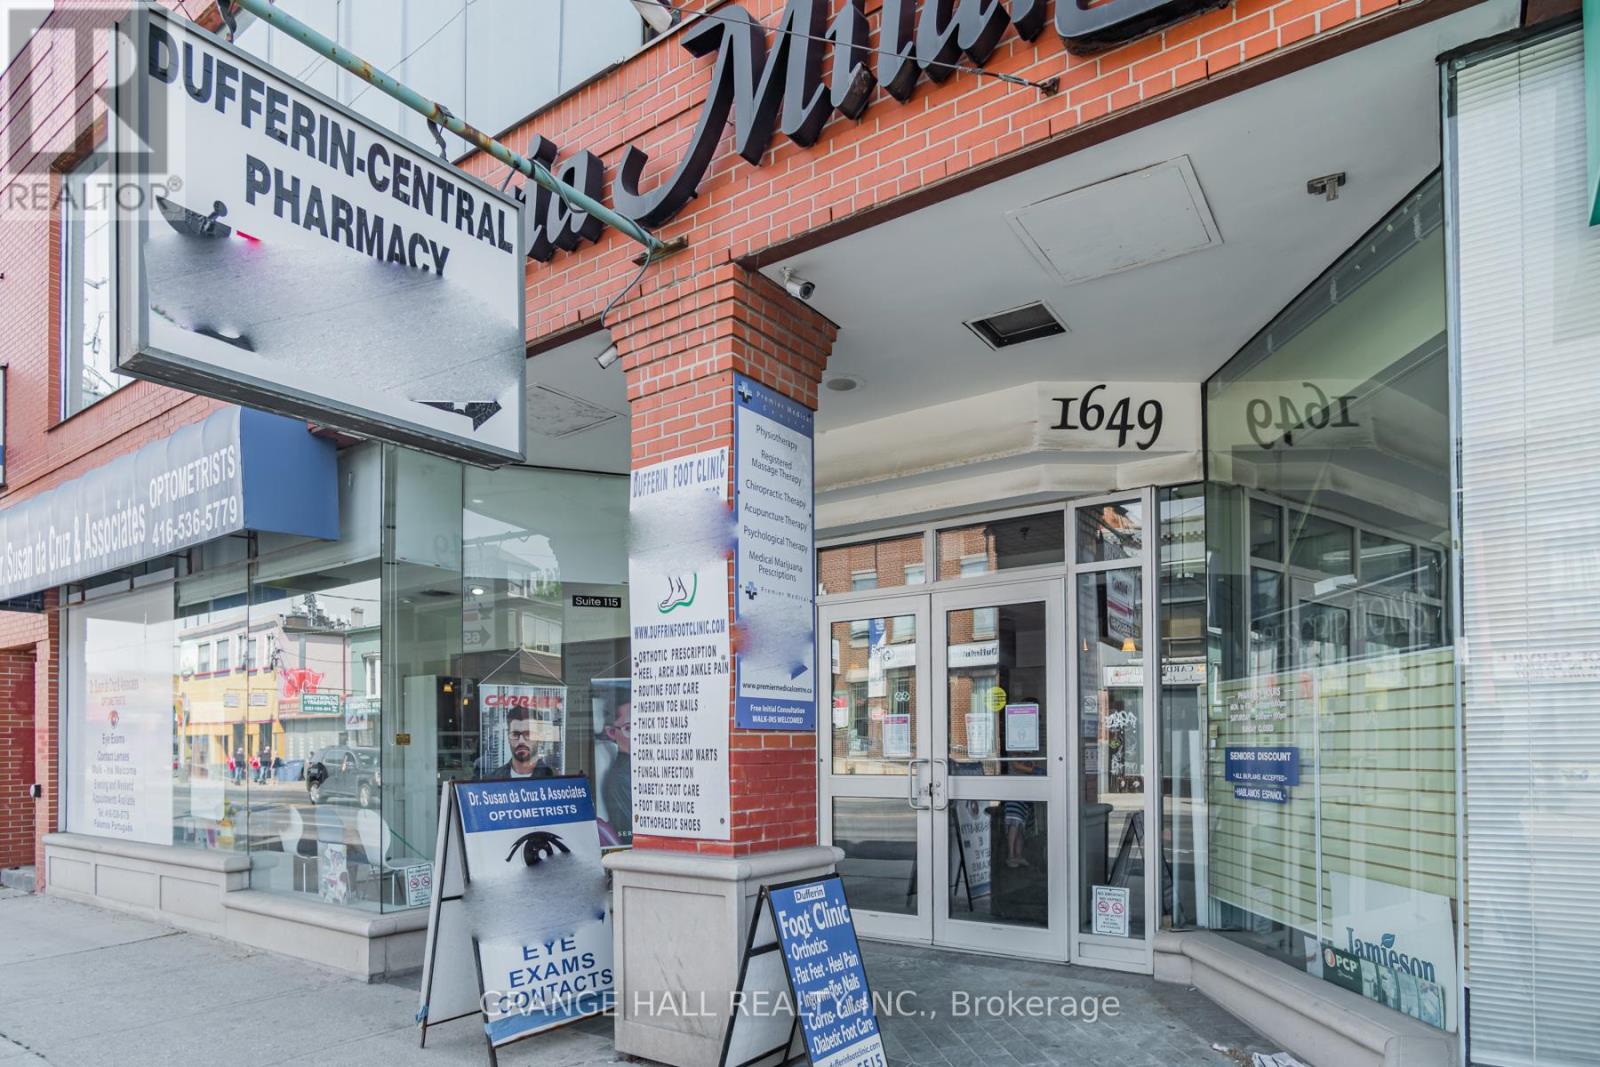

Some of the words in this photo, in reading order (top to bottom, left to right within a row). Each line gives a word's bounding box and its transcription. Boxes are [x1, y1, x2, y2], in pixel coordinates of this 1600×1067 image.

[148, 22, 514, 254] DUFFERIN-CENTRAL
[245, 153, 450, 277] PHARMACY
[1050, 384, 1163, 450] 1649
[755, 424, 798, 452] Physiotherapy
[761, 449, 793, 470] Registered
[149, 445, 235, 509] OPTOMETRISTS
[633, 467, 669, 498] DUFFERIN
[673, 461, 694, 488] FOOT
[697, 454, 725, 483] CLINIC
[751, 457, 778, 477] Massage
[779, 468, 802, 487] Therapy
[745, 479, 783, 500] Chiropractic
[784, 492, 807, 511] Therapy
[152, 496, 237, 548] 416-536-5779
[744, 502, 784, 523] Acupuncture
[785, 515, 807, 533] Therapy
[8, 541, 33, 585] Susan
[35, 538, 46, 575] da
[49, 526, 71, 571] Cruz
[73, 516, 81, 564] &
[84, 502, 146, 559] Associates
[744, 525, 785, 545] Psychological
[785, 537, 808, 555] Therapy
[749, 550, 774, 565] Medical
[774, 557, 803, 573] Marijuana
[758, 564, 797, 582] Prescriptions
[575, 597, 601, 606] Suite
[603, 597, 618, 607] 115
[639, 649, 667, 663] ORTHOTIC
[671, 645, 717, 660] PRESCRIPTION
[659, 665, 674, 678] ARCH
[676, 665, 688, 677] AND
[690, 663, 711, 676] ANKLE
[714, 661, 729, 674] PAIN
[639, 684, 663, 697] ROUTINE
[665, 682, 680, 696] FOOT
[682, 681, 699, 694] CARE
[638, 701, 664, 713] INGROWN
[667, 700, 678, 712] TOE
[680, 699, 698, 711] NAILS
[750, 704, 762, 712] Free
[638, 717, 655, 729] THICK
[657, 716, 668, 728] TOE
[670, 716, 688, 728] NAILS
[638, 733, 661, 745] TOENAIL
[664, 732, 692, 744] SURGERY
[657, 749, 679, 761] CALLUS
[681, 749, 693, 761] AND
[695, 748, 718, 761] WARTS
[1230, 751, 1255, 761] SENIORS
[1257, 752, 1292, 762] DISCOUNT
[638, 766, 660, 778] FUNGAL
[662, 766, 694, 779] INFECTION
[468, 791, 482, 806] Dr.
[483, 790, 507, 805] Susan
[509, 789, 519, 803] da
[520, 789, 538, 802] Cruz
[540, 787, 546, 800] &
[548, 785, 587, 800] Associates
[638, 783, 664, 796] DIABETIC
[665, 783, 681, 796] FOOT
[683, 784, 700, 797] CARE
[1236, 787, 1260, 799] HABLAMOS
[489, 804, 577, 821] OPTOMETRISTS
[639, 800, 653, 811] FOOT
[654, 800, 670, 813] WEAR
[672, 801, 695, 814] ADVICE
[640, 816, 677, 830] ORTHOPAEDIC
[680, 818, 701, 832] SHOES
[795, 888, 824, 901] Dufferin
[778, 909, 813, 940] Foot
[812, 899, 850, 930] Clinic
[792, 937, 828, 961] Orthotics
[1344, 926, 1436, 983] Jamieson
[510, 952, 595, 988] EXAMS
[795, 965, 810, 984] Flat
[809, 962, 825, 980] Feet
[827, 956, 844, 974] Heel
[843, 950, 859, 970] Pain
[1335, 954, 1358, 972] PCP
[499, 968, 613, 1014] CONTACTS
[829, 979, 843, 996] Toe
[842, 972, 860, 991] Nails
[836, 995, 869, 1019] Calluses
[813, 1028, 842, 1055] Diabetic
[841, 1023, 858, 1042] Foot
[856, 1017, 874, 1035] Care
